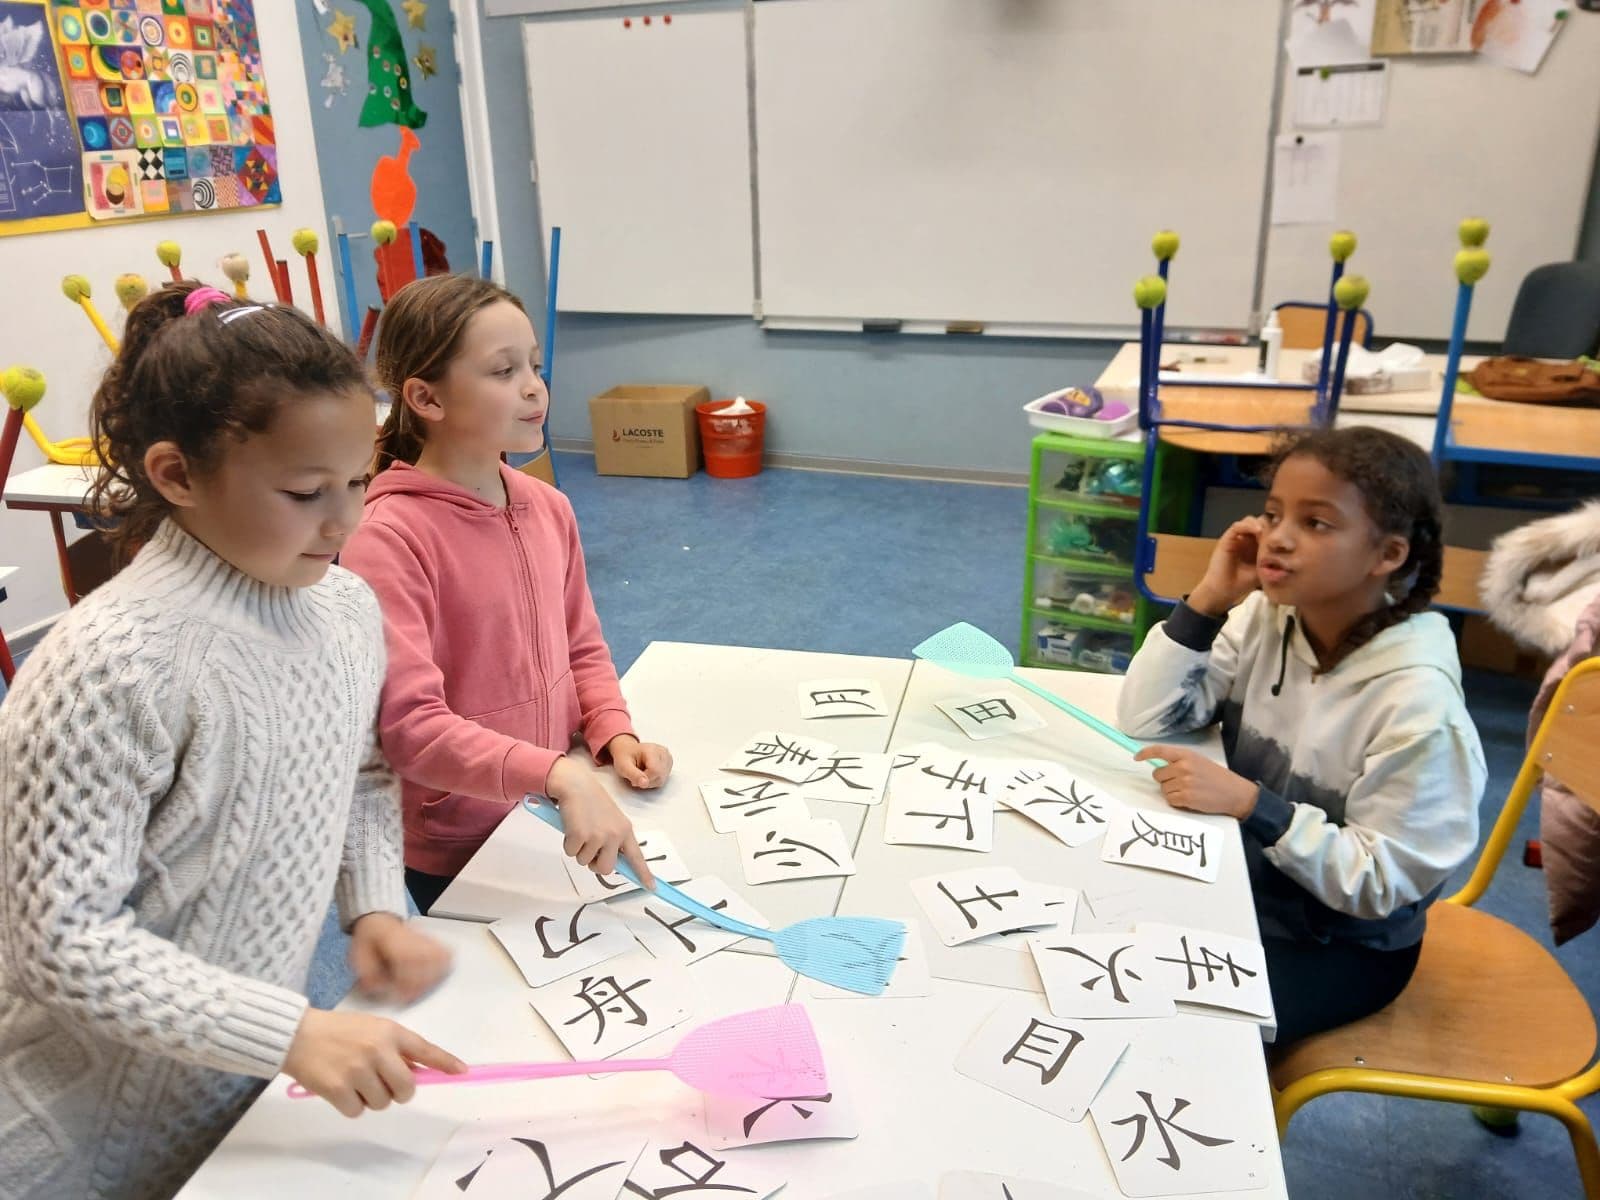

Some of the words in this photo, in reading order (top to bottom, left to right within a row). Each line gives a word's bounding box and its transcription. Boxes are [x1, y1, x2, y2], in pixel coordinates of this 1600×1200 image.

[622, 428, 664, 437] LACOSTE
[810, 689, 875, 709] 月
[956, 698, 1017, 725] 田
[745, 735, 818, 767] 春
[803, 757, 873, 790] 天
[921, 759, 987, 794] 手
[720, 780, 789, 817] 云
[904, 798, 975, 841] 下
[1024, 780, 1105, 824] 米
[1120, 812, 1206, 868] 夏
[1046, 945, 1142, 1003] 火
[1155, 935, 1257, 990] 车
[563, 976, 651, 1045] 舟
[1003, 1018, 1085, 1085] 目
[1111, 1091, 1234, 1170] 水
